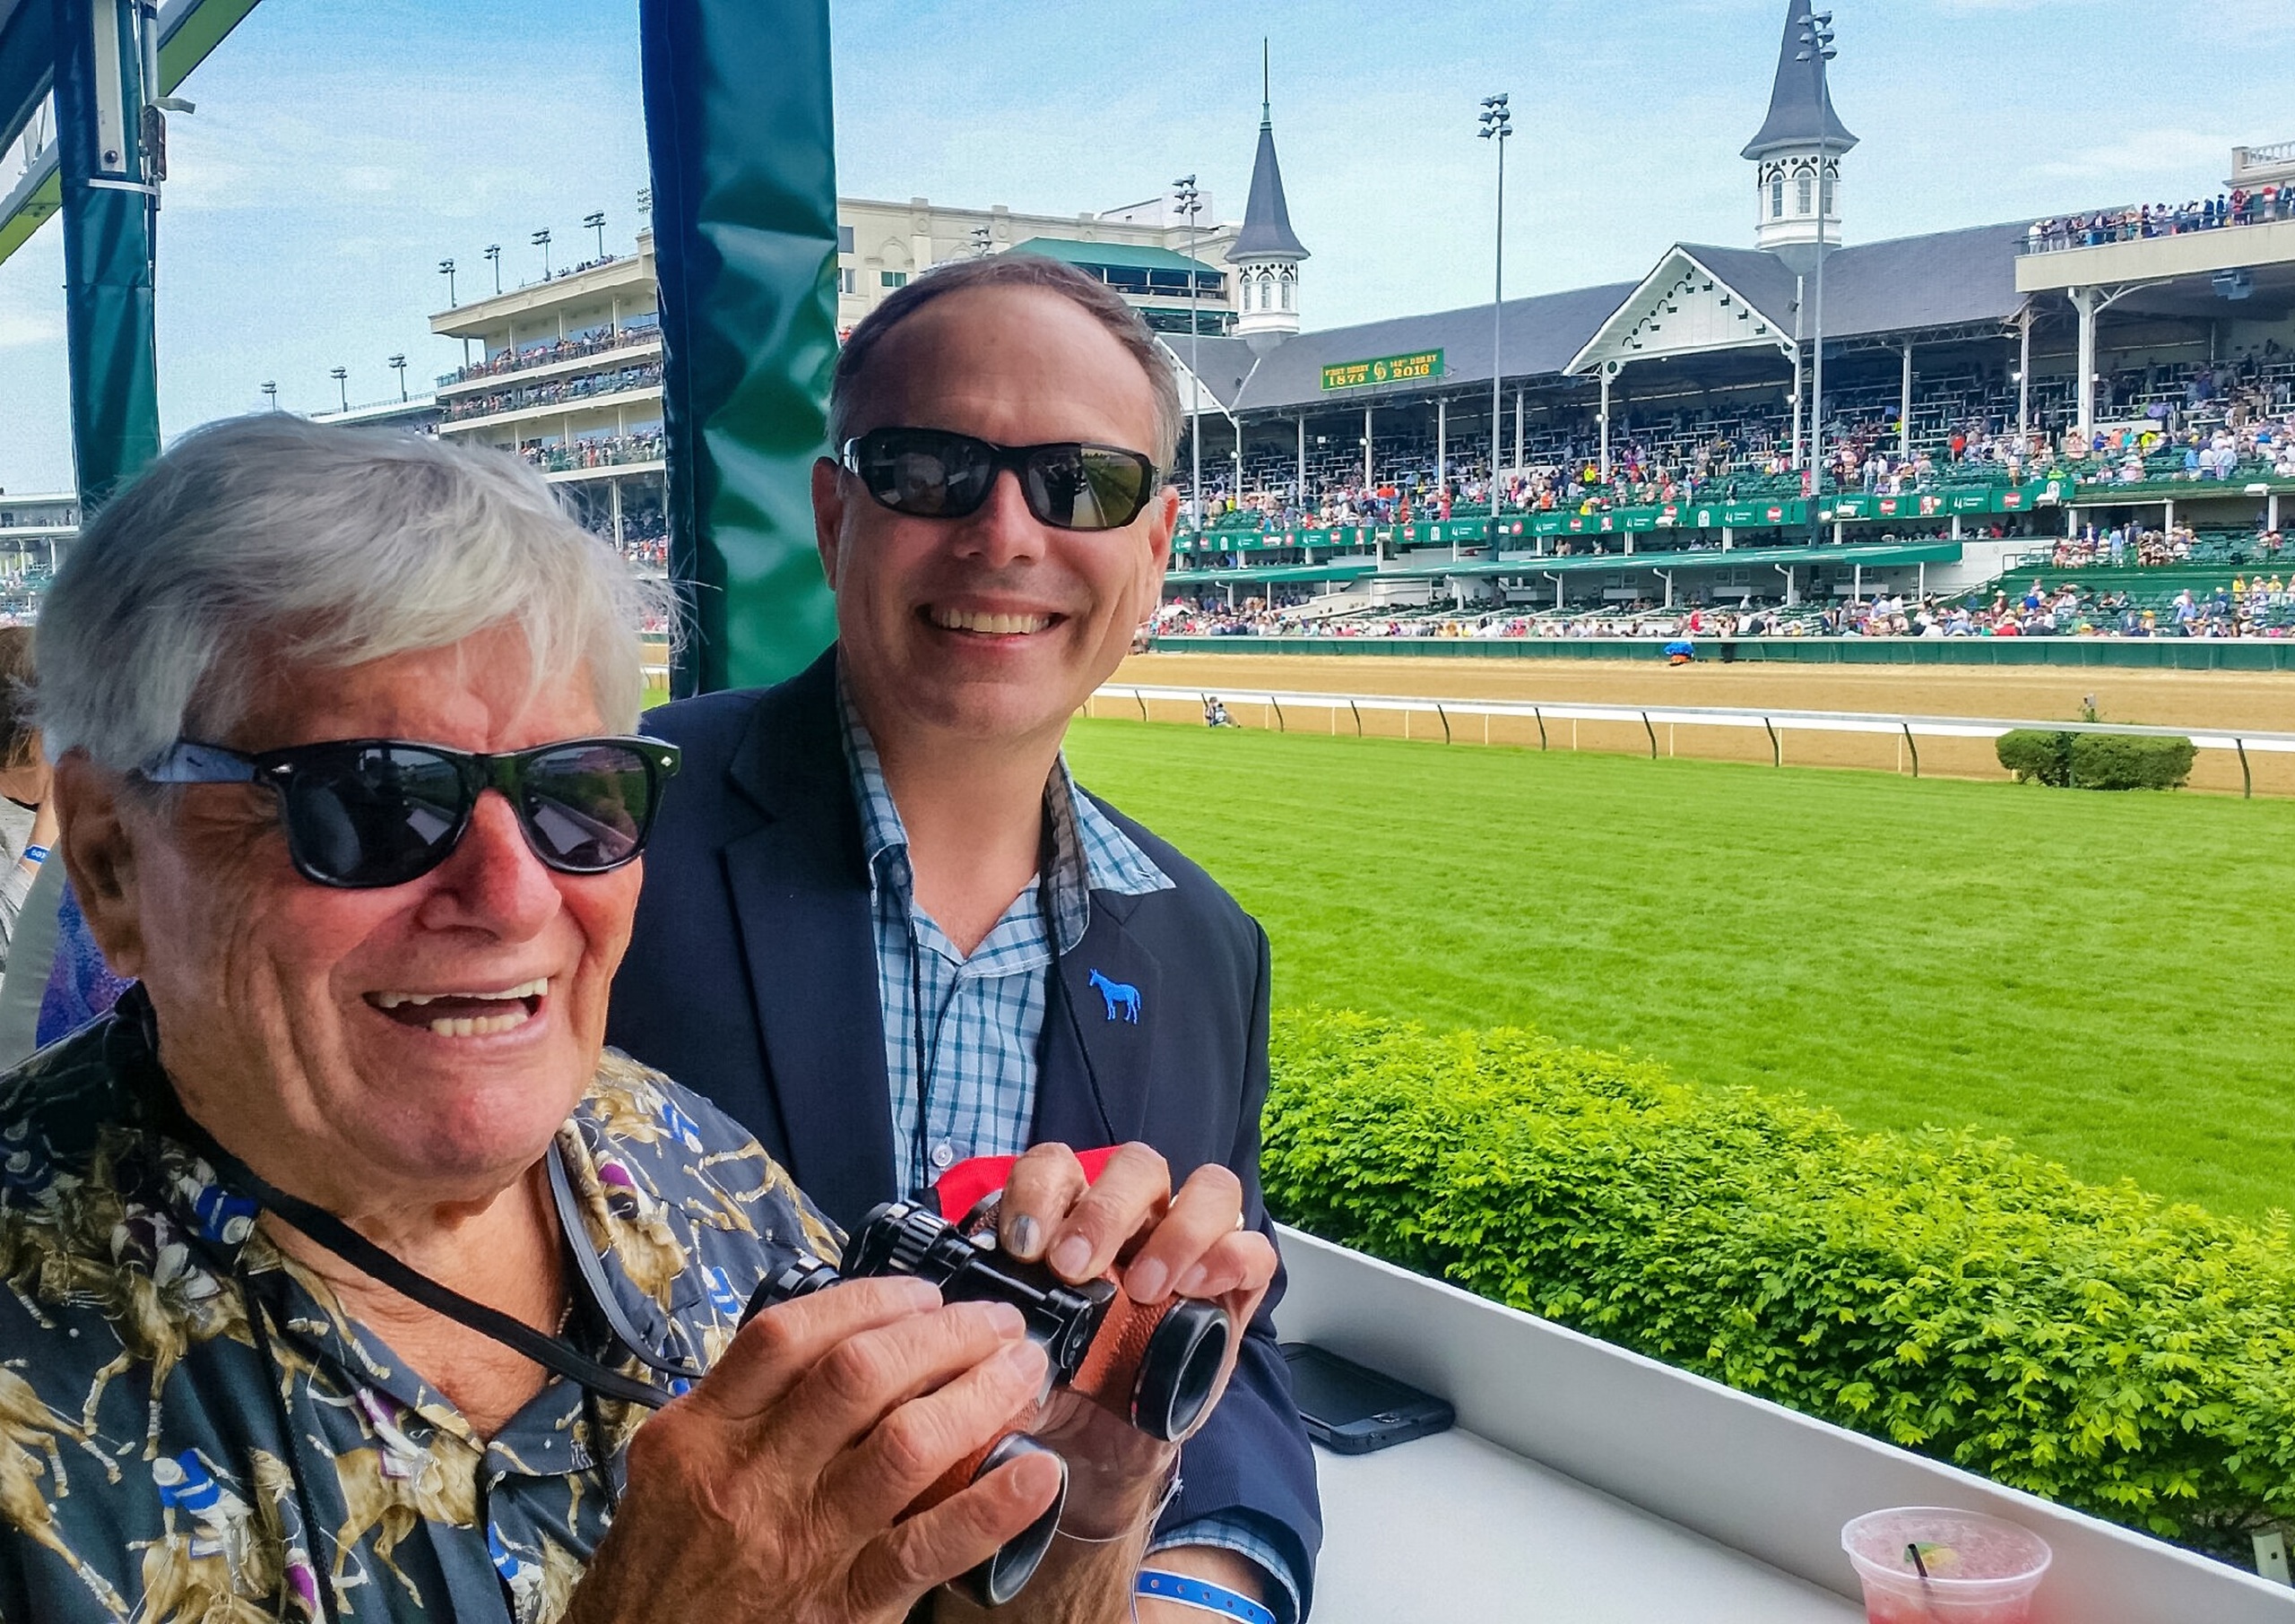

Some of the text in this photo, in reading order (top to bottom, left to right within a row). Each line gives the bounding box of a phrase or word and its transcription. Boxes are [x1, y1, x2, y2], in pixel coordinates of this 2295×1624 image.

[1410, 354, 1437, 365] DERBY
[1347, 364, 1370, 374] DERBY
[1393, 364, 1430, 377] 2016
